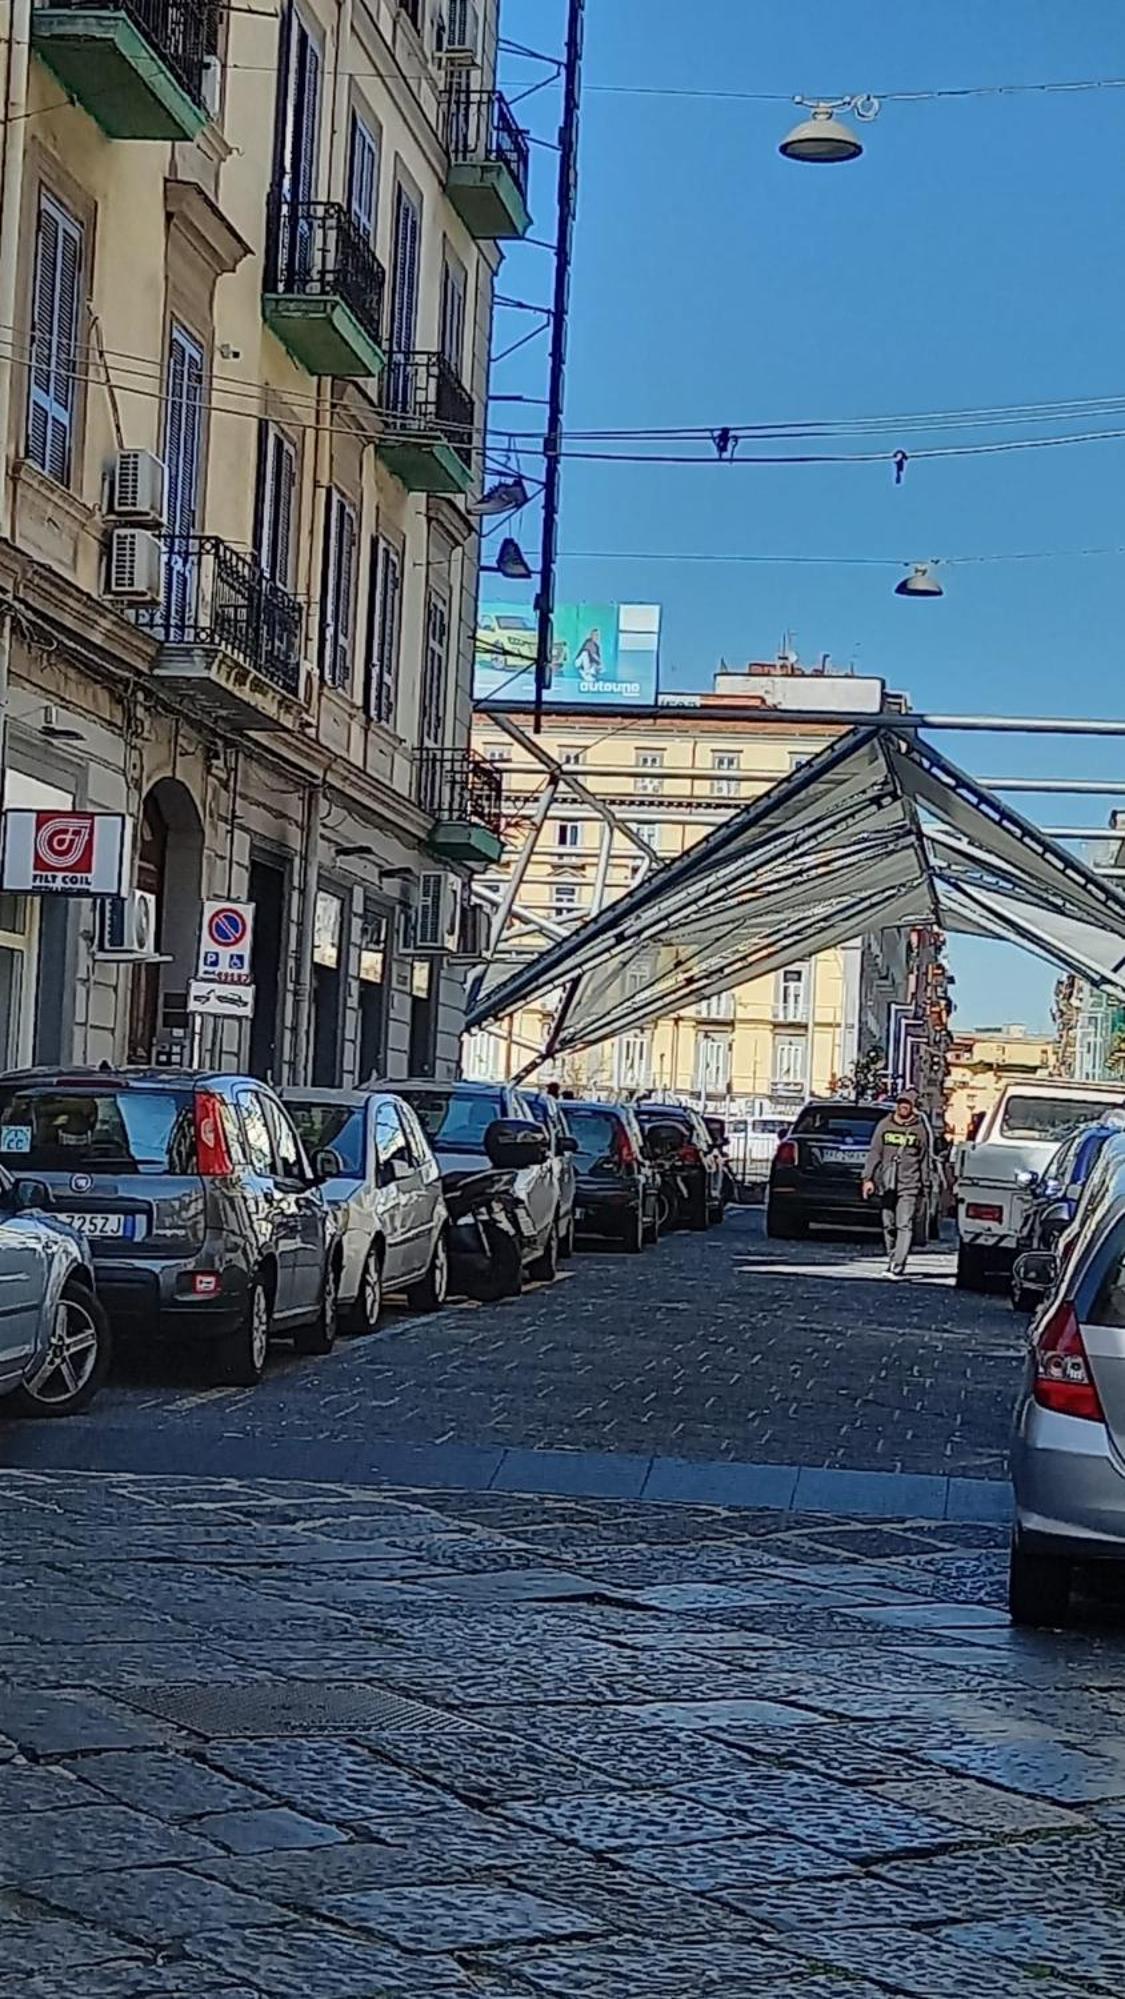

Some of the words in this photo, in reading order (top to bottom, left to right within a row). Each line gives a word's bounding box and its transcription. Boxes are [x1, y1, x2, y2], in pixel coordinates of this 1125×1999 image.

[579, 681, 640, 692] autouno
[61, 875, 92, 886] COIL
[207, 953, 217, 966] P
